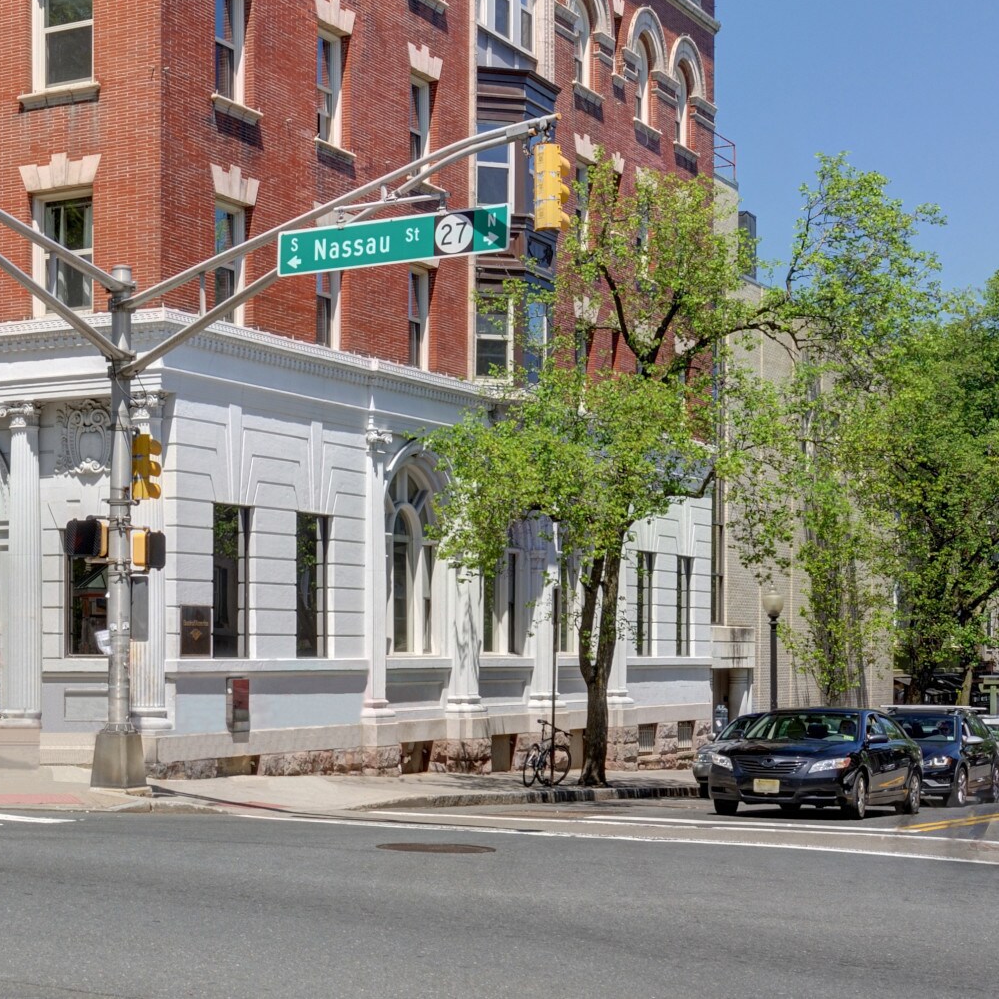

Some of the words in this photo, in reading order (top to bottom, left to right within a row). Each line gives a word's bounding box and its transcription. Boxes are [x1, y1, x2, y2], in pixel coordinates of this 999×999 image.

[487, 212, 497, 228] N
[440, 221, 468, 246] 27
[290, 237, 299, 252] S
[314, 235, 390, 261] Nassau
[405, 227, 420, 242] St
